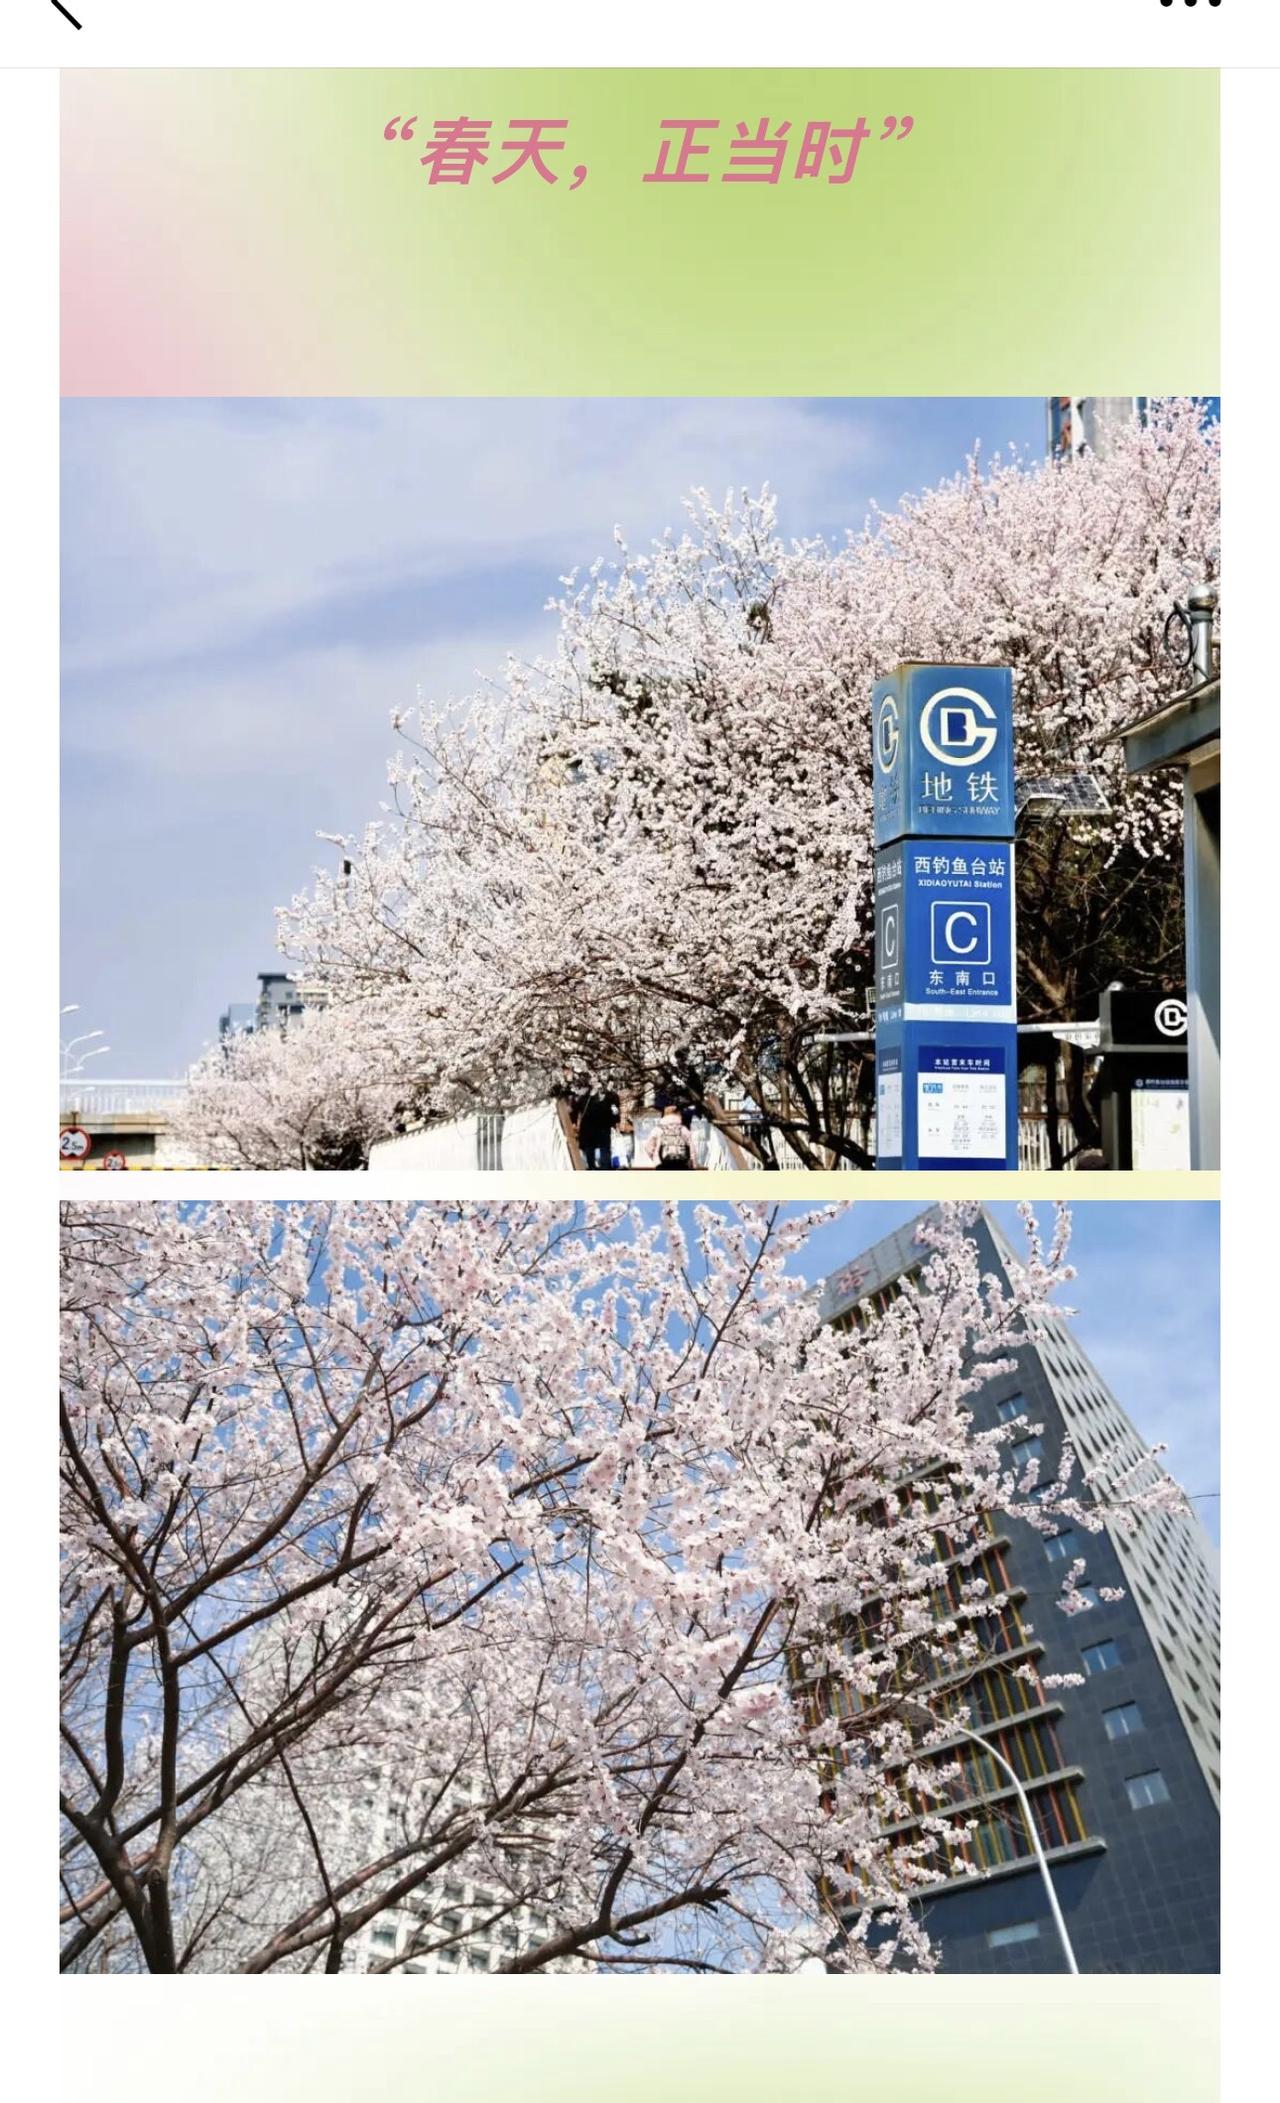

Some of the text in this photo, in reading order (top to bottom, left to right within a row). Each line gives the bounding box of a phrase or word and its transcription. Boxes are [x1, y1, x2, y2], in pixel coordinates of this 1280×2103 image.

[921, 770, 999, 803] 地铁
[914, 856, 1006, 876] 西钓鱼台站
[918, 879, 1003, 889] XIDIAOYUTAI Station
[885, 915, 896, 957] C
[945, 911, 978, 954] C
[929, 969, 996, 986] 东南口
[967, 988, 999, 997] Entrance
